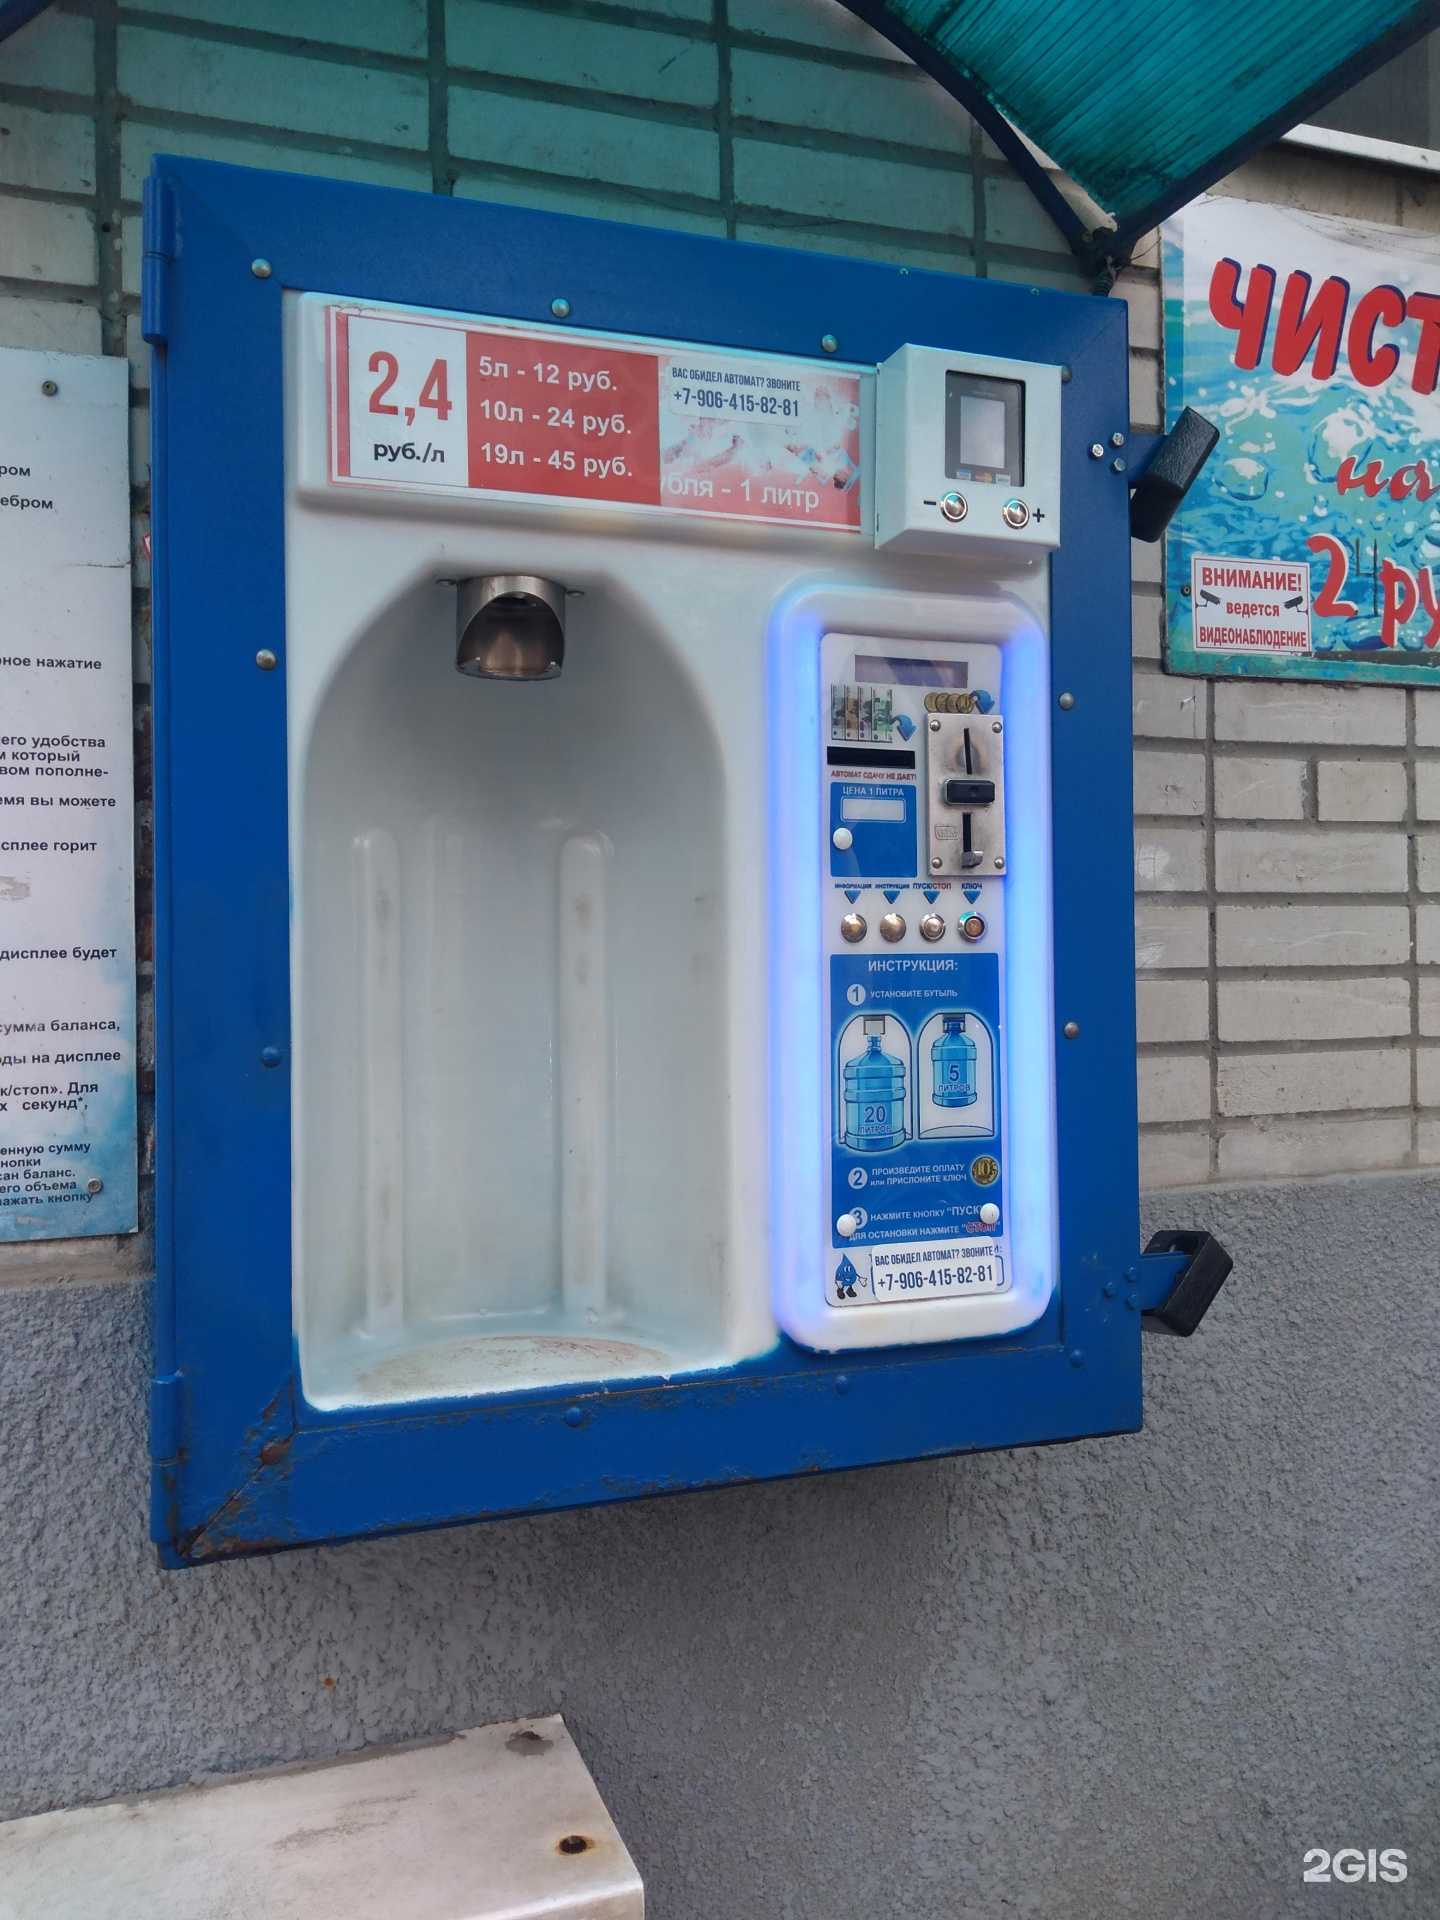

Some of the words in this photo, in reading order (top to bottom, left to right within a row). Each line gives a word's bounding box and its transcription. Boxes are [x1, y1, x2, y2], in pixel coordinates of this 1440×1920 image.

[1208, 257, 1440, 396] ЧИСТ
[479, 355, 509, 378] 5л
[532, 362, 560, 384] 12
[567, 370, 617, 393] руб.
[672, 367, 688, 380] ВАС
[689, 368, 722, 383] ОБИДЕЛ
[724, 372, 765, 388] АВТОМАТ?
[766, 376, 801, 391] ЗВОНИТЕ
[367, 350, 453, 427] 2,4
[673, 387, 799, 417] +7-906-415-82-81
[480, 399, 523, 423] 10л
[547, 406, 575, 428] 24
[583, 414, 632, 436] руб.
[373, 442, 445, 463] руб./л
[481, 442, 524, 465] 19л
[548, 449, 576, 471] 45
[583, 456, 632, 479] руб.
[661, 471, 714, 499] бля
[740, 479, 751, 502] 1
[761, 485, 820, 513] литр
[0, 494, 53, 510] ебром
[1201, 567, 1302, 592] ВНИМАНИЕ!
[1306, 532, 1359, 617] 2
[1226, 601, 1280, 618] ведется
[1199, 626, 1307, 648] ВИДЕОНАБЛЮДЕНИЕ
[0, 656, 31, 667] ное
[36, 656, 102, 670] нажатие
[1, 736, 27, 746] его
[31, 735, 106, 749] удобства
[11, 750, 80, 764] который
[35, 766, 109, 777] пополне-
[831, 769, 861, 778] АВТОМАТ
[842, 786, 866, 796] ЦЕНА
[875, 787, 905, 796] ЛИТРА
[30, 796, 54, 806] вы
[59, 797, 117, 808] можете
[1, 841, 49, 851] сплее
[53, 841, 98, 854] горит
[961, 882, 983, 890] КЛЮЧ
[0, 949, 67, 961] дисплее
[72, 946, 118, 961] будет
[868, 959, 959, 973] ИНСТРУКЦИЯ:
[851, 985, 859, 1002] 1
[870, 990, 922, 999] УСТАНОВИТЕ
[924, 989, 959, 998] БУТЫЛЬ
[0, 1023, 46, 1036] умма
[50, 1019, 121, 1032] баланса,
[0, 1055, 26, 1067] ды
[31, 1054, 50, 1064] на
[54, 1051, 121, 1066] дисплее
[949, 1064, 960, 1082] 5
[67, 1081, 99, 1096] Для
[864, 1105, 887, 1123] 20
[0, 1145, 44, 1157] енную
[48, 1143, 91, 1156] сумму
[1, 1158, 41, 1168] нопки
[872, 1166, 931, 1176] ПРОИЗВЕДИТЕ
[933, 1163, 965, 1173] ОПЛАТУ
[0, 1172, 19, 1181] ан
[23, 1169, 76, 1180] баланс.
[852, 1169, 864, 1187] 2
[886, 1176, 942, 1185] ПРИСЛОНИТЕ
[943, 1174, 967, 1183] КЛЮЧ
[25, 1181, 77, 1192] объема
[0, 1196, 44, 1206] ажать
[47, 1193, 95, 1204] кнопку
[870, 1212, 913, 1221] НАЖМИТЕ
[913, 1208, 946, 1218] КНОПКУ
[868, 1229, 918, 1240] ОСТАНОВКИ
[919, 1226, 960, 1237] НАЖМИТЕ
[875, 1255, 890, 1266] ВАС
[891, 1253, 921, 1265] ОБИДЕЛ
[922, 1249, 960, 1263] АВТОМАТ?
[961, 1246, 994, 1259] ЗВОНИТЕ
[877, 1264, 993, 1291] +7-906-415-82-81
